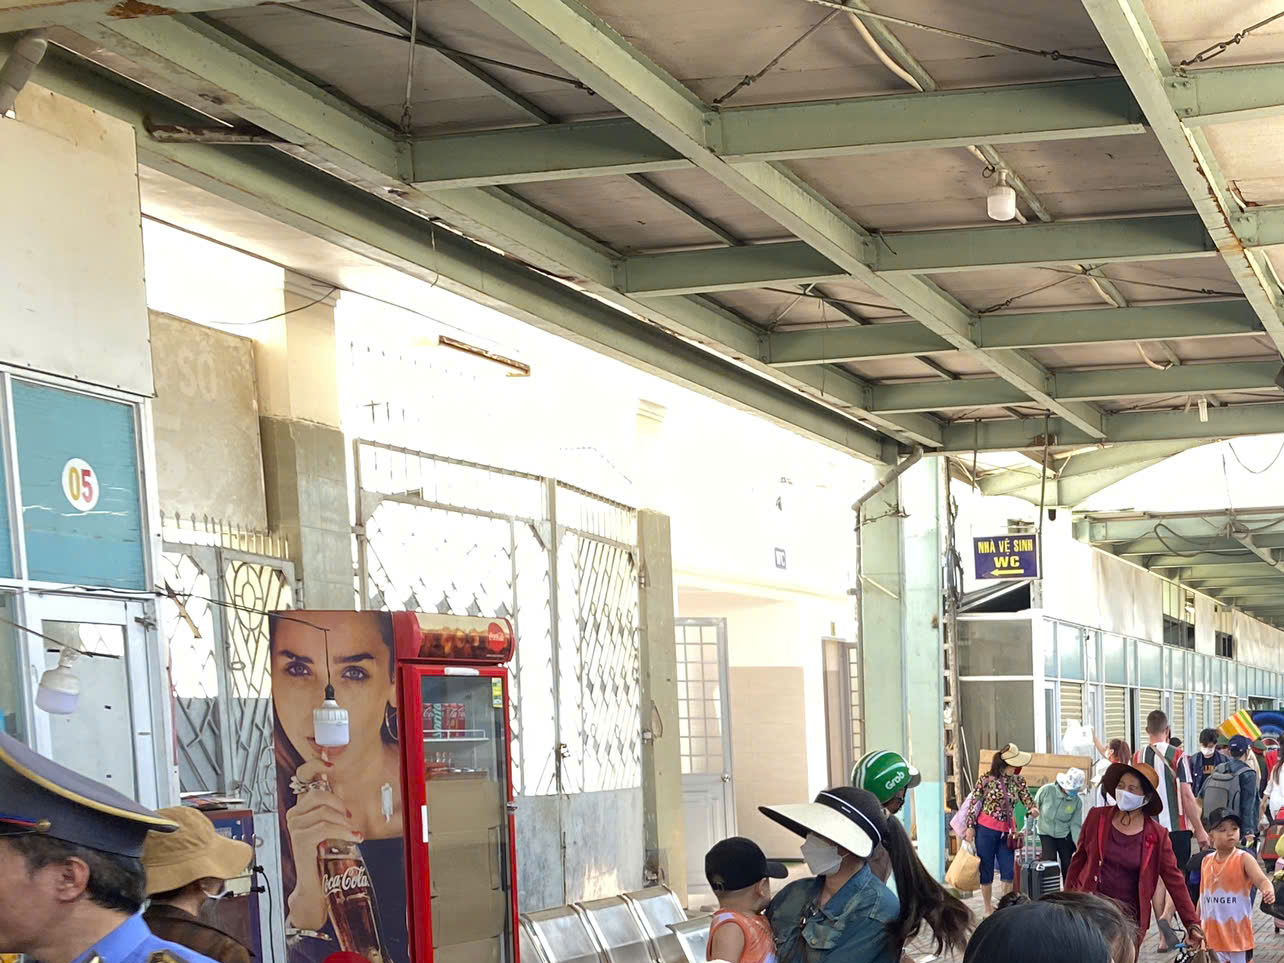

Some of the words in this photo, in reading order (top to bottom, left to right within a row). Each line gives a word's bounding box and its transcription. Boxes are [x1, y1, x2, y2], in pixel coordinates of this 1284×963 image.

[69, 467, 93, 503] 05
[978, 539, 996, 553] NHÀ
[999, 538, 1011, 555] VỆ
[1013, 539, 1033, 552] SINH
[994, 556, 1020, 568] WC
[885, 771, 905, 790] Grab
[322, 866, 370, 896] Coca-Cola
